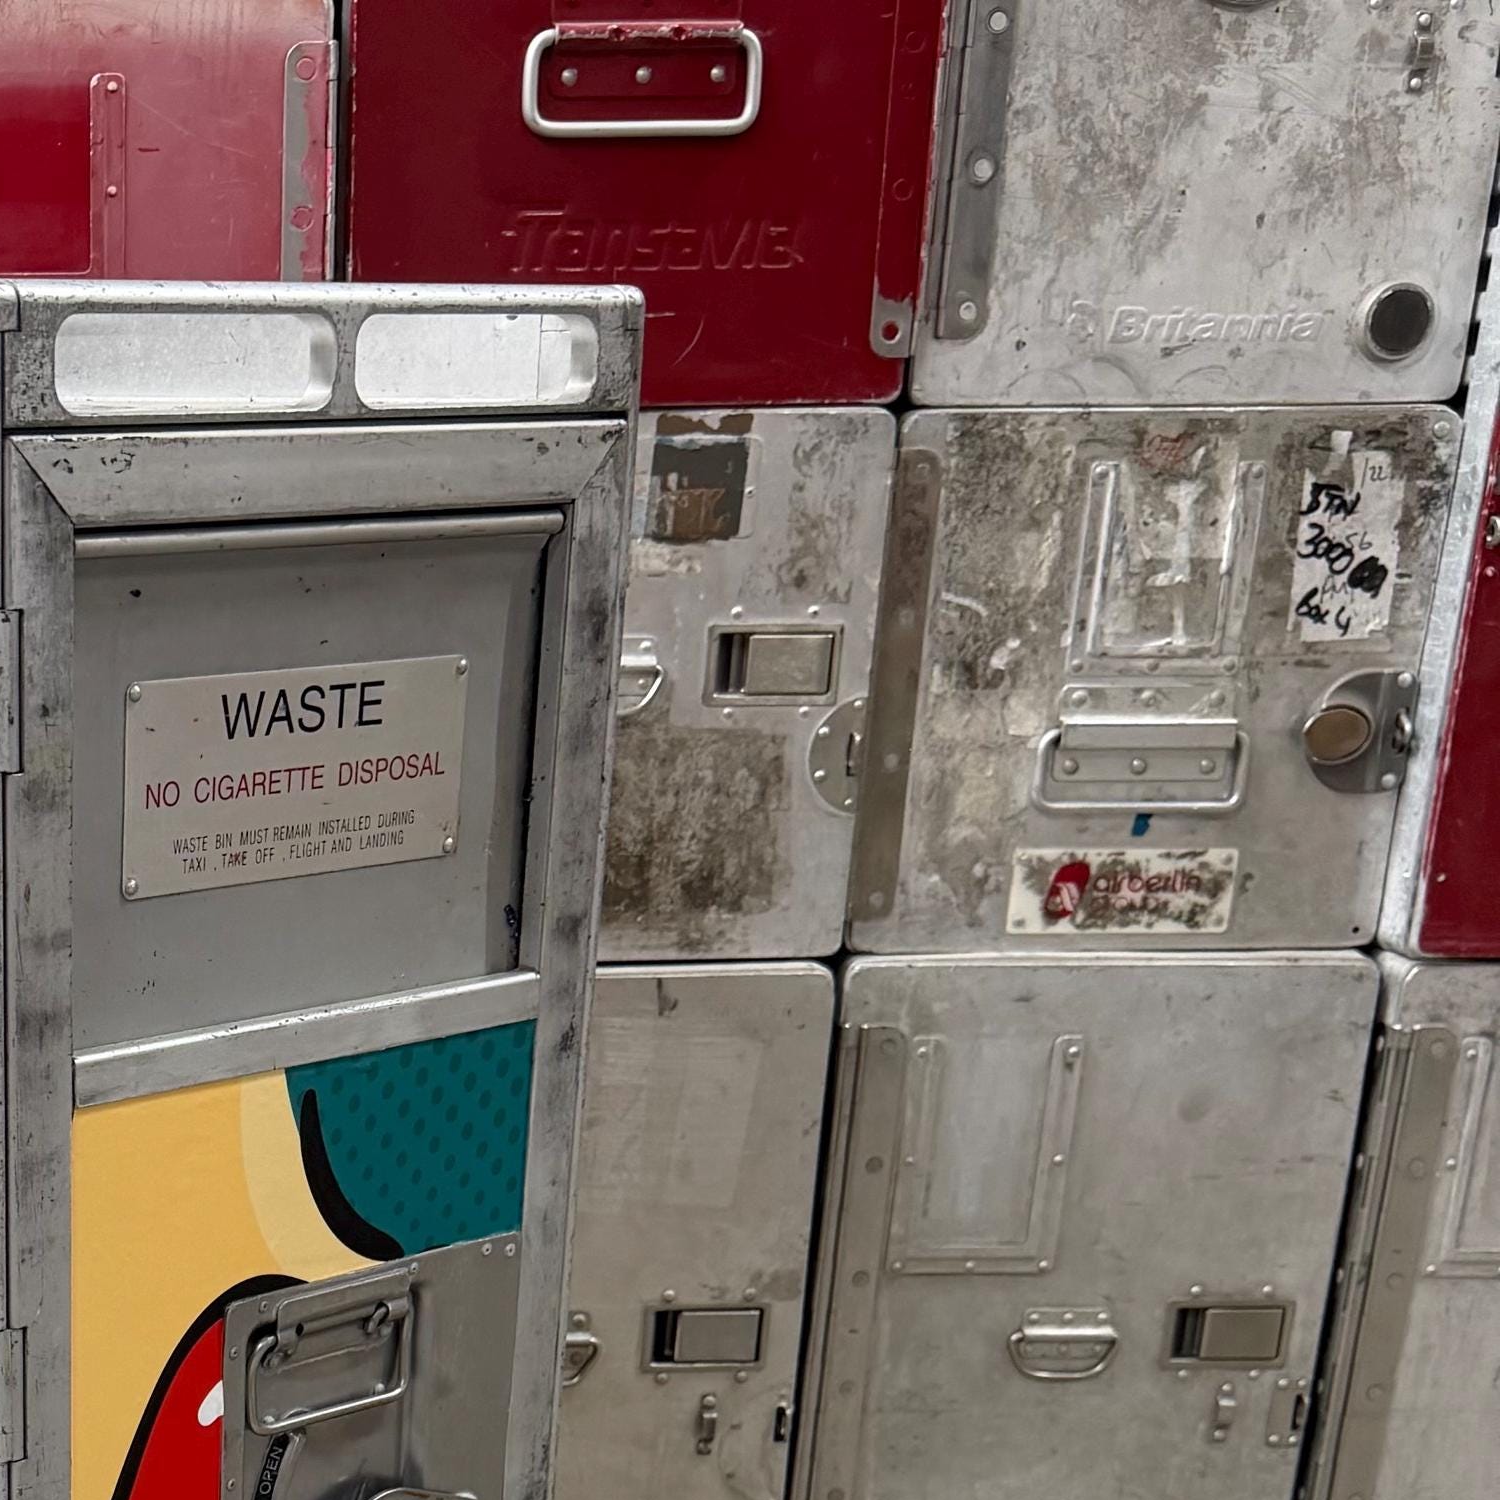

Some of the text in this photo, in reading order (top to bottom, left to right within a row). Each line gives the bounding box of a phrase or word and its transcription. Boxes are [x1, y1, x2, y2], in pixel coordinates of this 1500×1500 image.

[1107, 304, 1325, 343] Britannia
[221, 680, 385, 740] WASTE
[145, 751, 445, 809] NO CIGARETTE DISPOSAL
[173, 809, 415, 854] WASTE BIN MUST REMAIN INSTALLED DURING
[222, 851, 247, 869] TAKE
[255, 847, 274, 865] OFF
[290, 840, 326, 860] FLIGHT
[331, 836, 352, 854] AND
[360, 830, 404, 850] LANDING
[259, 1446, 283, 1495] OPEN
